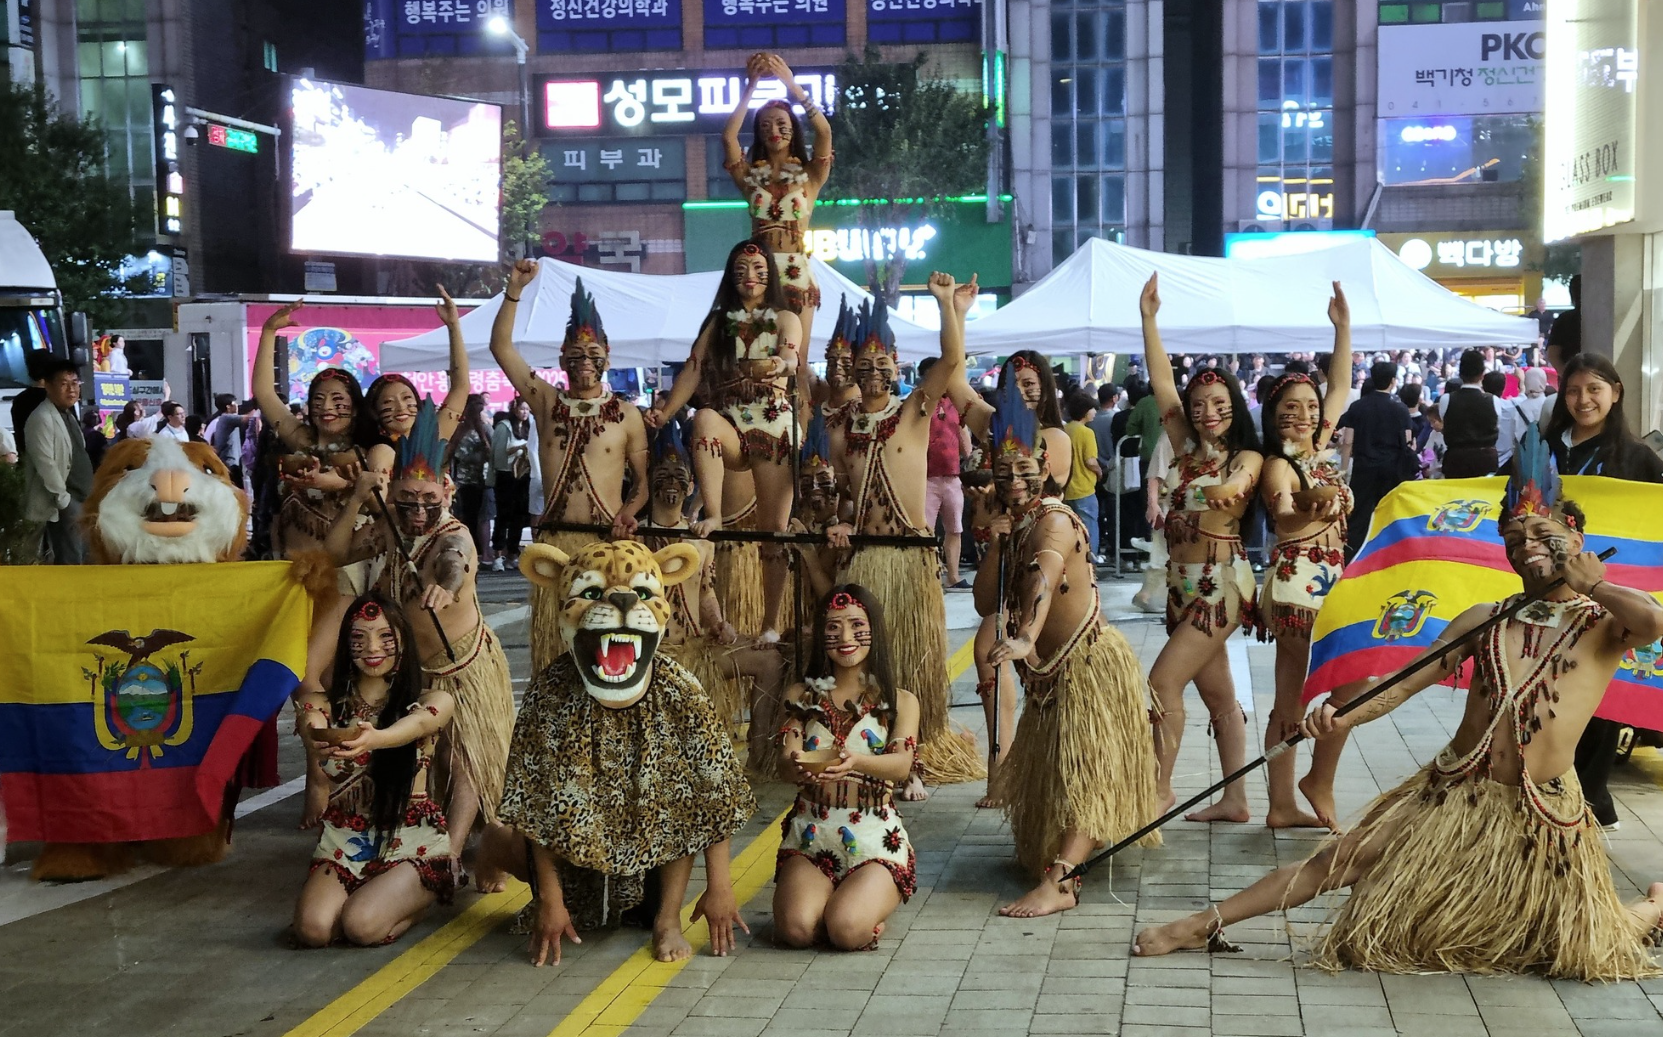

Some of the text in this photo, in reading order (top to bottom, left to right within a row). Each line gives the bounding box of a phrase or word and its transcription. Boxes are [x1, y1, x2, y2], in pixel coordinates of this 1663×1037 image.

[404, 0, 471, 24] 행복주는
[1415, 68, 1473, 87] 백기청
[564, 149, 662, 169] 피부과
[1595, 139, 1618, 178] BOX
